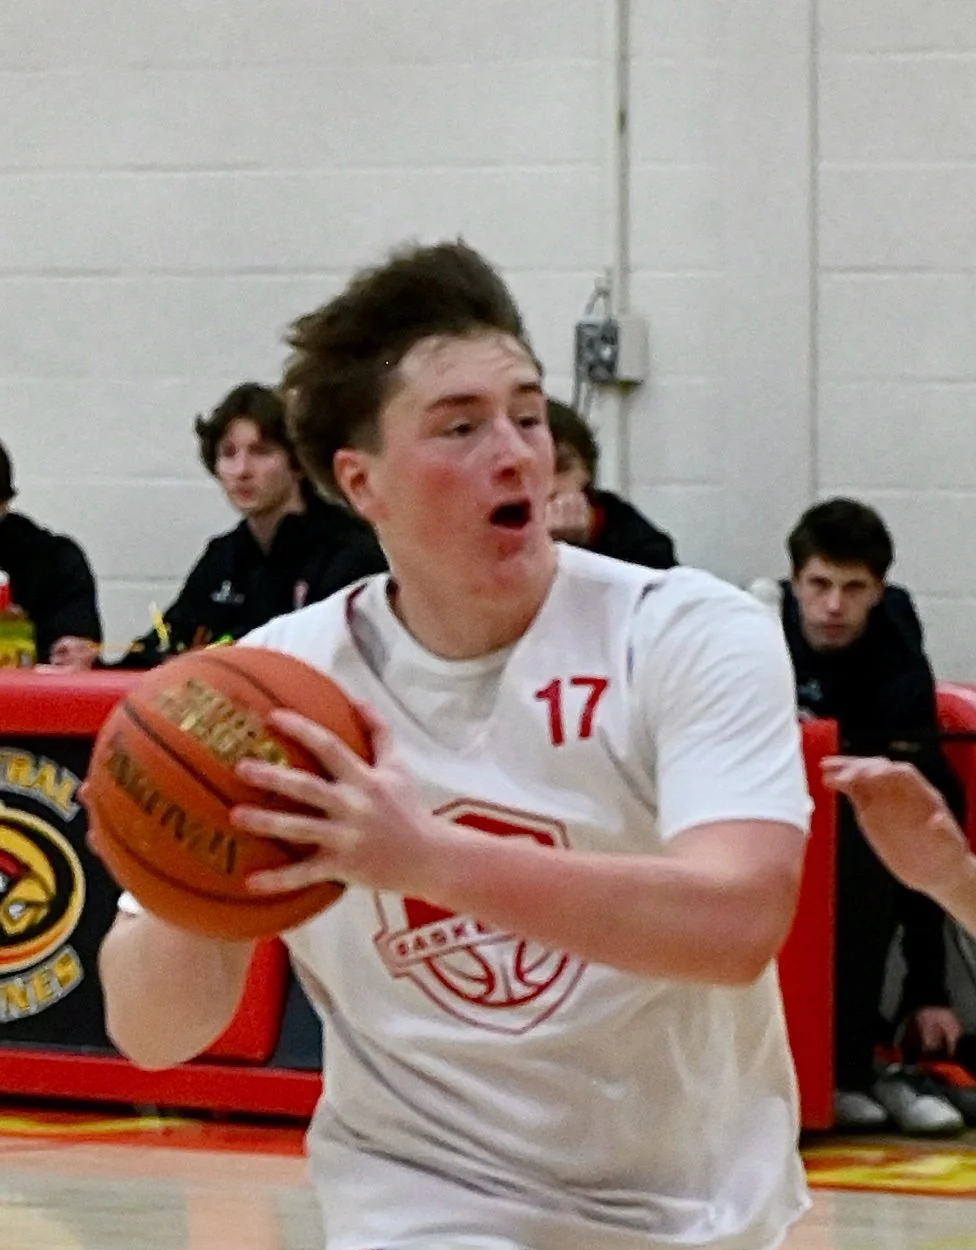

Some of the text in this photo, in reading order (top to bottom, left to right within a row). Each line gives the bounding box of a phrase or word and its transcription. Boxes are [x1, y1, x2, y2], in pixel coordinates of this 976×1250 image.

[534, 675, 609, 747] 17
[0, 748, 81, 821] RAL
[0, 947, 83, 1019] NES
